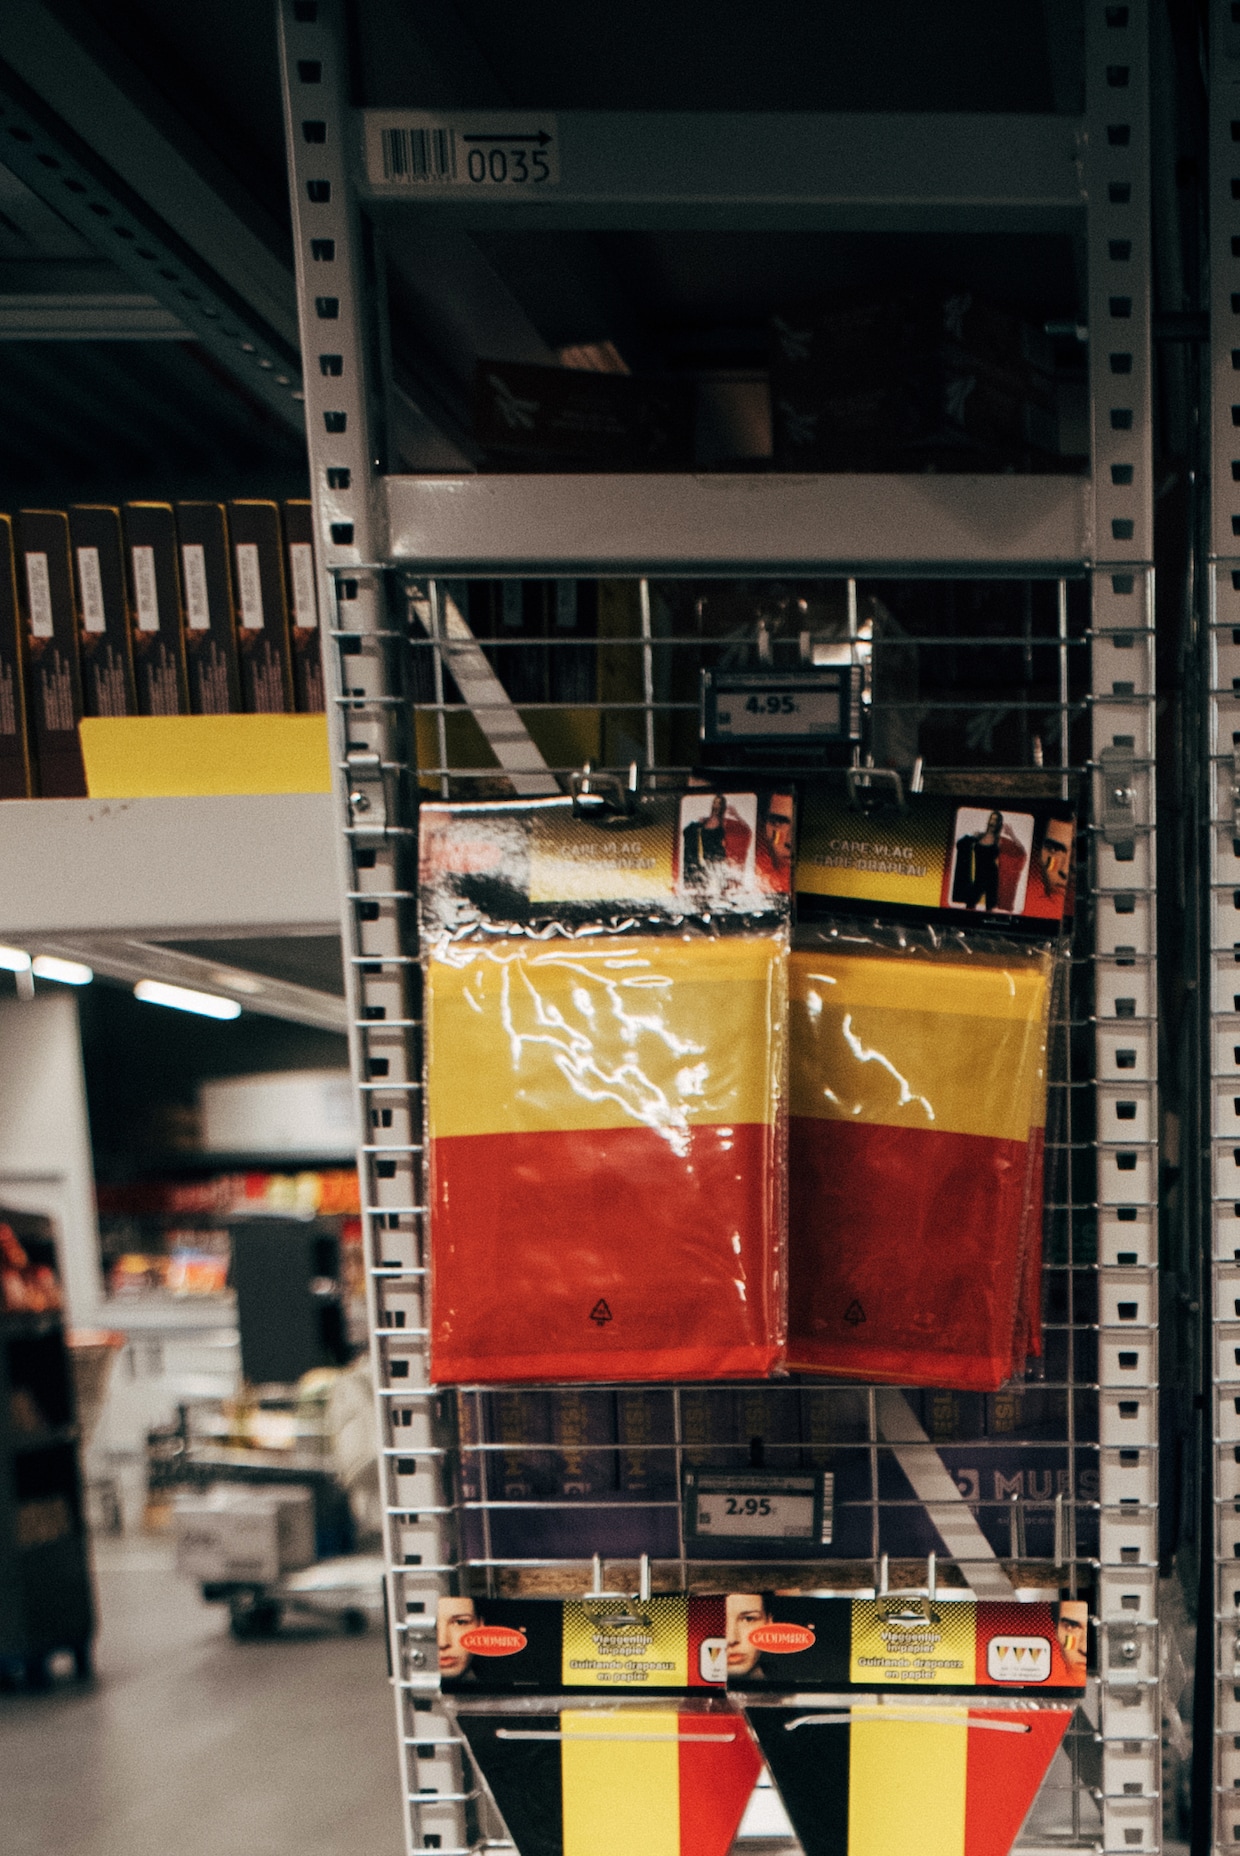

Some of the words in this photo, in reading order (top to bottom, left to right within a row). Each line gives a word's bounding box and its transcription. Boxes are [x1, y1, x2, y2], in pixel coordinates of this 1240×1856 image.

[467, 148, 551, 183] 0035
[463, 1634, 522, 1649] GOODMARK
[592, 1633, 654, 1646] Vlaggenlijn
[751, 1631, 810, 1646] GOODMARK
[880, 1630, 942, 1643] Vlaggenlijn
[569, 1660, 623, 1670] Guirlande
[624, 1660, 677, 1672] drapeaux
[857, 1657, 911, 1668] Guirlande
[912, 1657, 965, 1670] drapeaux
[597, 1672, 611, 1681] en
[612, 1671, 649, 1683] papier
[884, 1670, 899, 1679] en
[900, 1669, 936, 1681] papier
